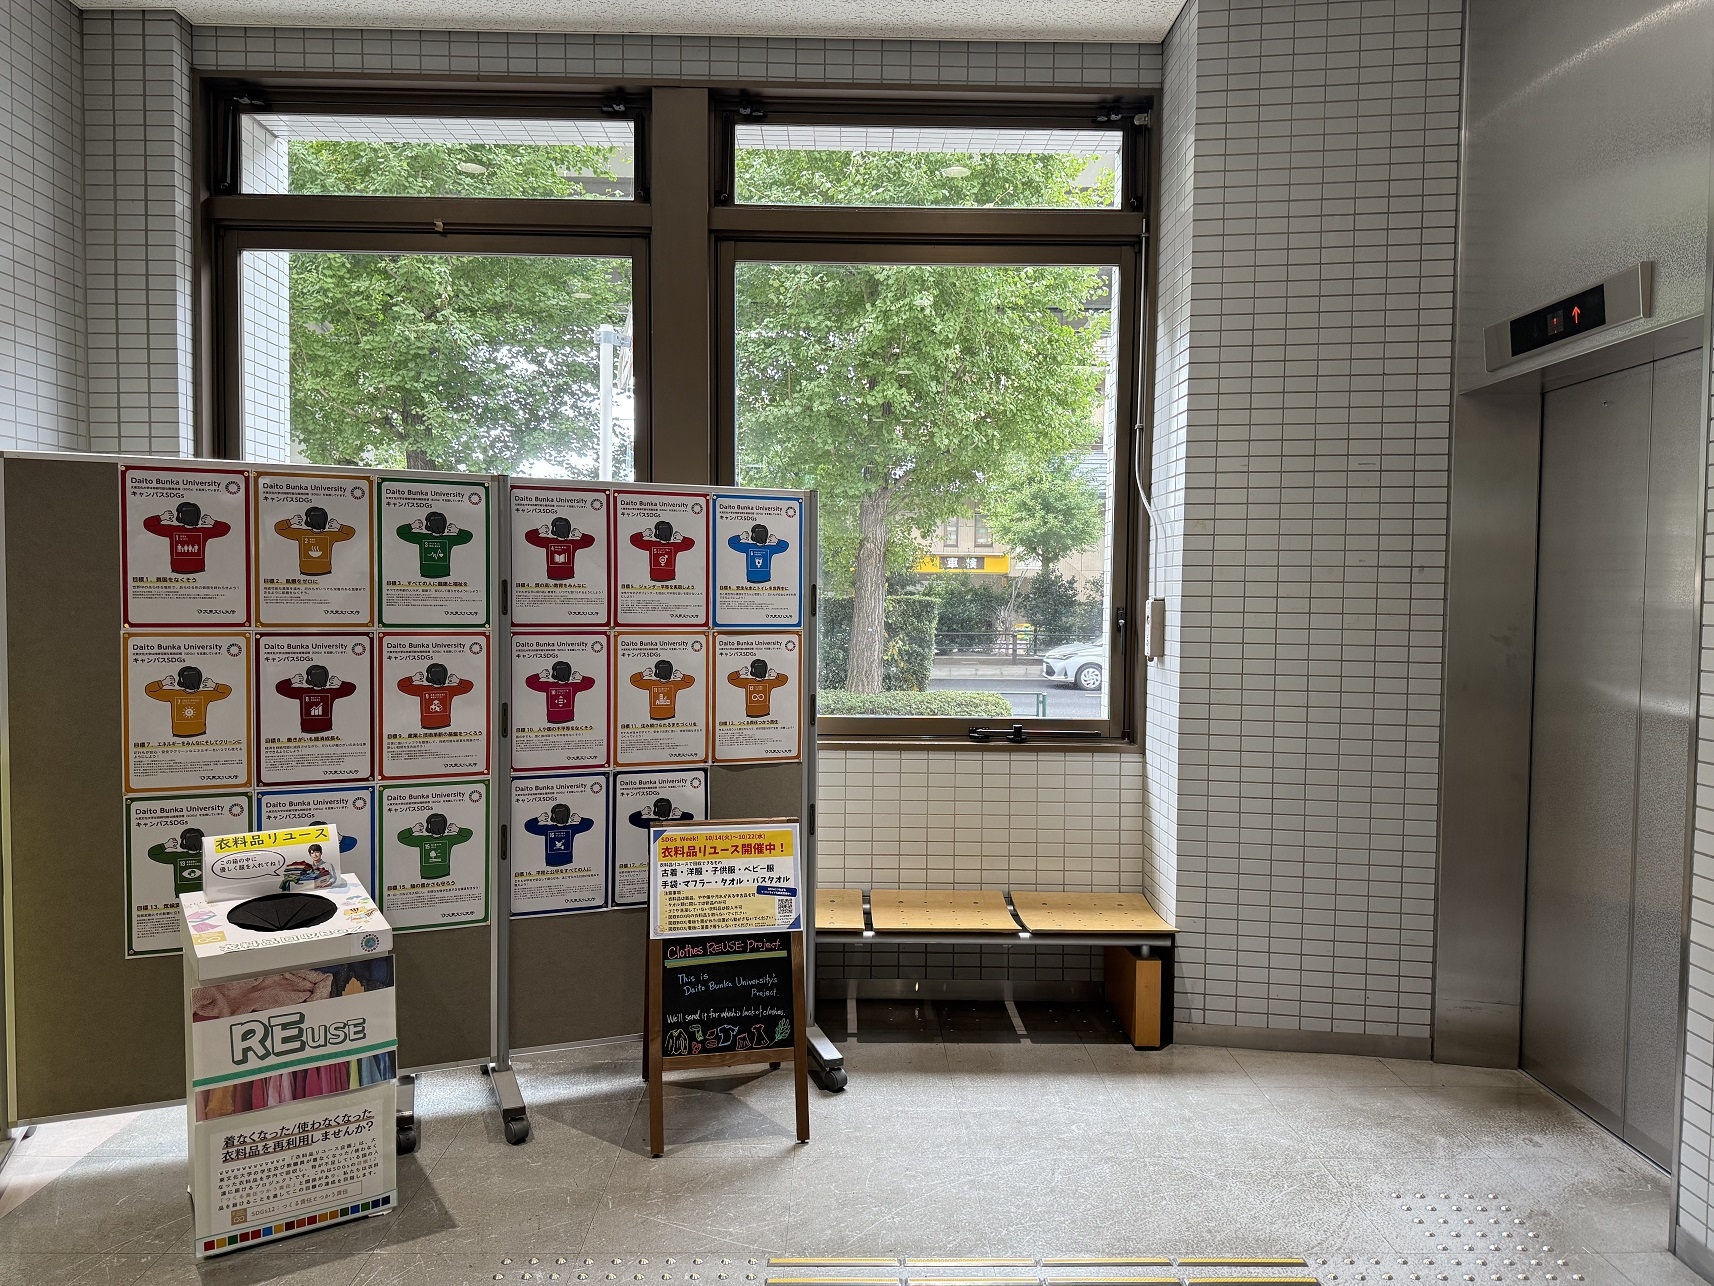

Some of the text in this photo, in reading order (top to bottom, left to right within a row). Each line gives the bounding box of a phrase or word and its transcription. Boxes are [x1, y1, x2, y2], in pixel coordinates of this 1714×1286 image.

[131, 477, 153, 485] Daito
[182, 480, 221, 488] University
[311, 484, 347, 493] University
[431, 490, 464, 498] University
[216, 828, 328, 850] 衣料品リユース
[662, 842, 785, 858] 衣料品リユース開催中！
[221, 857, 257, 866] この箱の中に
[662, 864, 775, 877] 古着・洋服・子供服・ベビー服
[662, 876, 791, 889] 手袋・マフラー・タオル・バスタオル
[668, 944, 704, 959] Clothes
[707, 941, 744, 954] REUSE
[678, 974, 695, 984] This
[683, 973, 778, 996] Daito Bunka University's
[667, 1013, 683, 1023] We'll
[685, 1010, 701, 1022] send
[702, 1011, 707, 1021] it
[709, 1009, 719, 1019] for
[223, 1108, 375, 1148] 着なくなった/使わなくなった
